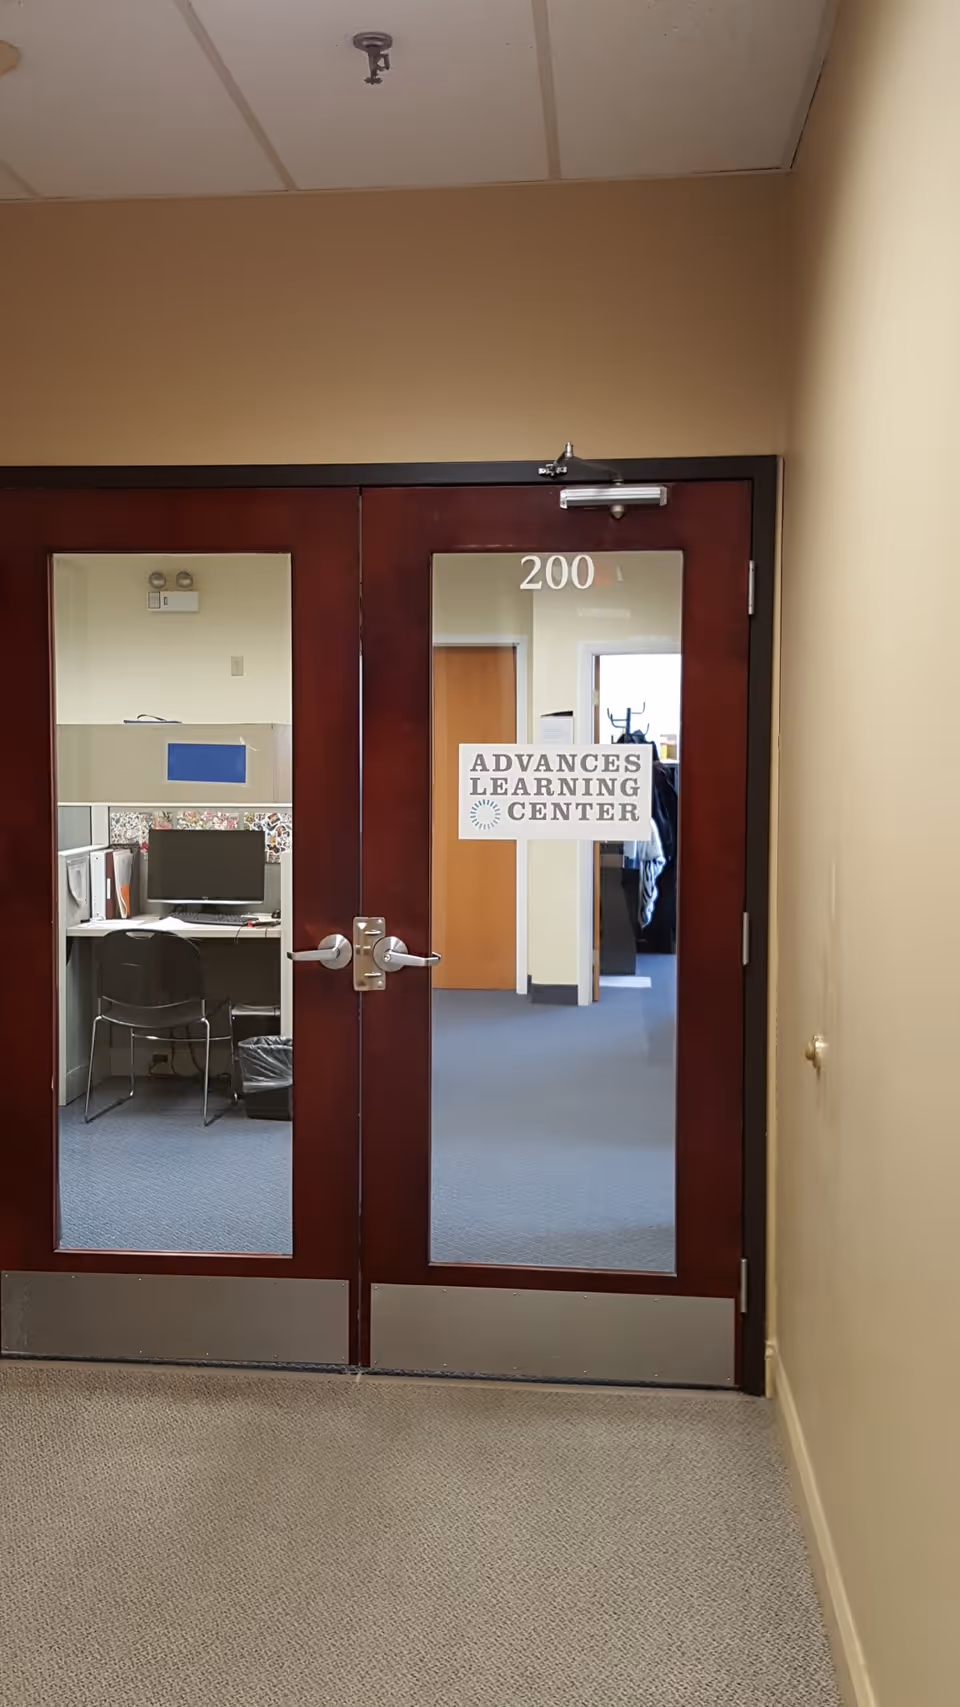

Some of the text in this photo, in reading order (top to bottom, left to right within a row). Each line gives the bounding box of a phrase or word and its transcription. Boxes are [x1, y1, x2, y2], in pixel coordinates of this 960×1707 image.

[520, 554, 595, 590] 200
[469, 753, 641, 773] ADVANCES
[469, 777, 641, 797] LEARNING
[507, 801, 640, 822] CENTER
